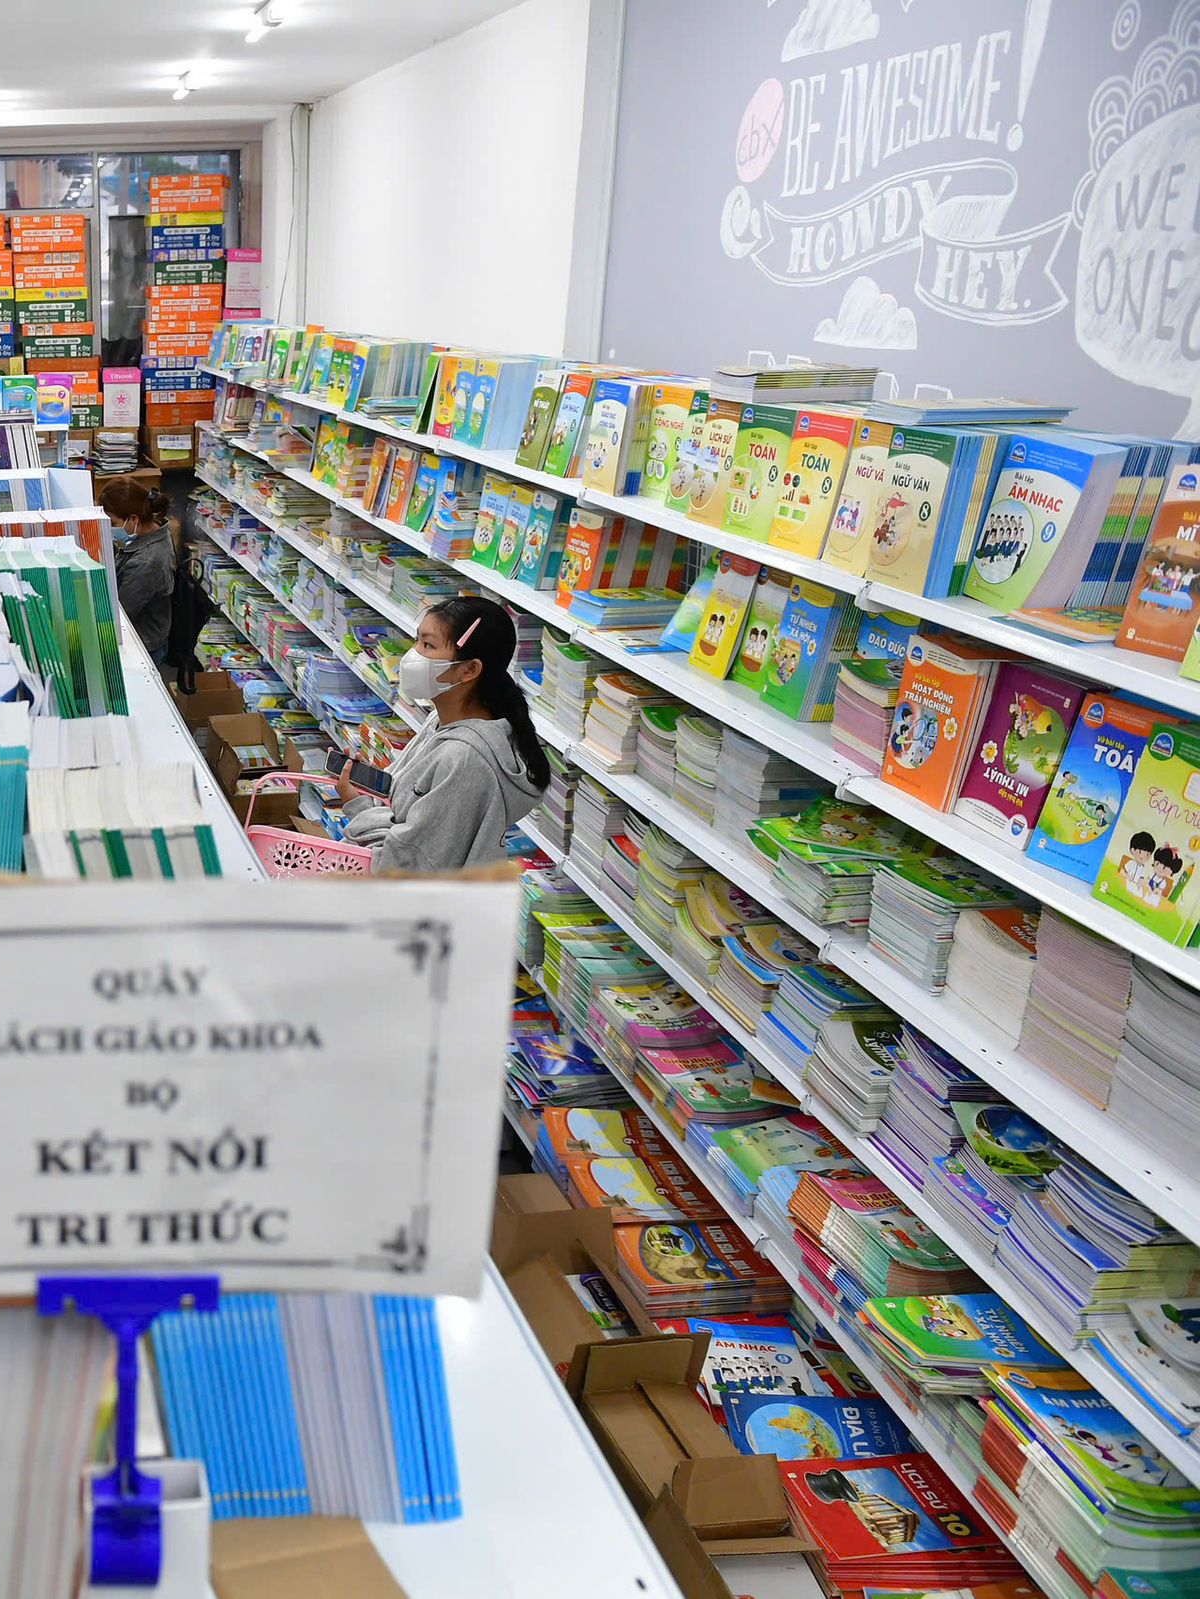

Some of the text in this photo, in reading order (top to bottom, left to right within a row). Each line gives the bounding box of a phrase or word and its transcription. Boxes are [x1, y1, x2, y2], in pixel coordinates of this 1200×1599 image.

[780, 74, 826, 198] BE
[1115, 163, 1200, 233] WE
[787, 174, 951, 274] HOWDY
[749, 442, 777, 461] TOÁN
[802, 453, 831, 473] TOÁN
[768, 465, 778, 482] 8
[821, 476, 833, 494] 8
[856, 465, 884, 482] NGỮ VĂ
[891, 473, 930, 493] NGỮ VĂN
[1014, 471, 1034, 485] Bài tập
[920, 501, 931, 521] 8
[1008, 485, 1064, 513] ÂM NHẠC
[1042, 522, 1056, 542] 9
[869, 633, 906, 658] ĐẠO ĐỨC
[904, 690, 952, 715] TRẢI NGHIỆM
[912, 682, 954, 705] HOẠT ĐỘNG
[1094, 743, 1140, 774] TOÁ
[983, 767, 1015, 789] THUẬT
[1148, 787, 1181, 825] Tập
[94, 1021, 197, 1054] GIÁO
[208, 1022, 325, 1053] KHOA
[126, 1079, 178, 1111] BỘ
[35, 1126, 270, 1177] KẾT NỐI
[17, 1200, 291, 1248] TRI THỨC
[715, 1339, 777, 1354] ÂM NHẠC
[1041, 1394, 1114, 1410] ÂM NHẠ
[842, 1407, 866, 1438] ĐỊA
[900, 1462, 929, 1490] LỊCH
[922, 1491, 950, 1510] SỬ
[938, 1513, 972, 1537] 10
